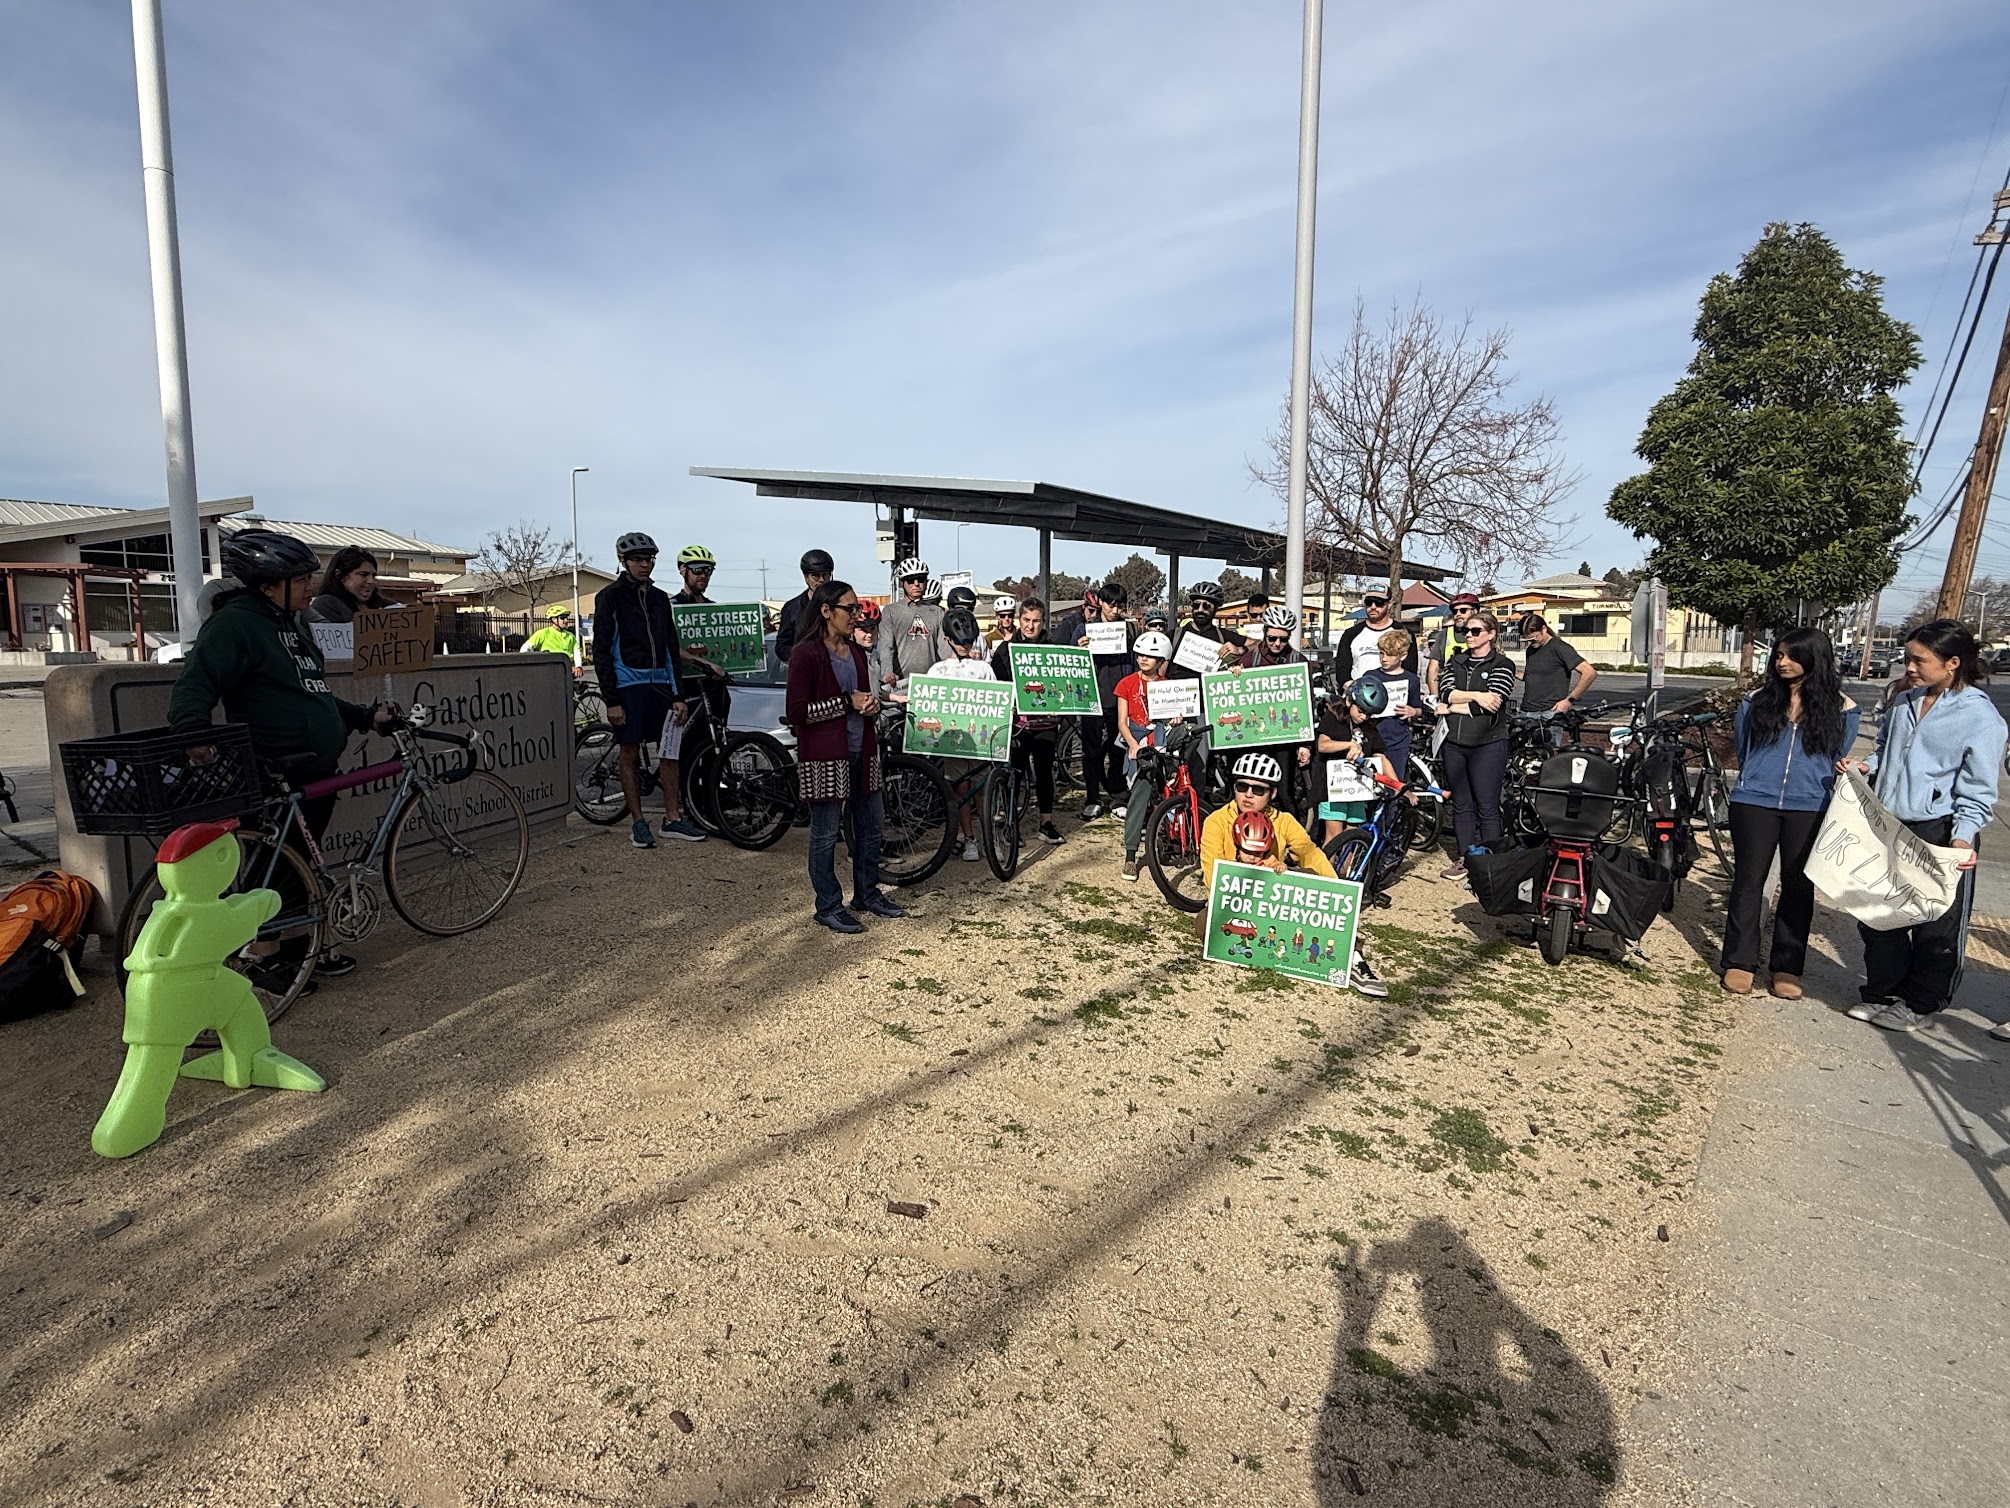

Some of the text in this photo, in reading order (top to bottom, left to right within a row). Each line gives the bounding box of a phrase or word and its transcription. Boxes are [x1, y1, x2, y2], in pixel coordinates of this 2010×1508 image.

[359, 610, 423, 634] INVEST
[677, 611, 759, 627] SAFE STREETS
[384, 632, 398, 642] IN
[681, 624, 757, 639] FOR EVERYONE
[358, 639, 430, 671] SAFETY
[1015, 652, 1091, 668] SAFE STREETS
[1018, 666, 1091, 679] FOR EVERYONE
[913, 684, 1009, 706] SAFE STREETS
[1208, 673, 1304, 696] SAFE STREETS
[413, 677, 527, 728] Gardens
[915, 700, 1005, 718] FOR EVERYONE
[1212, 689, 1302, 709] FOR EVERYONE
[482, 721, 557, 771] School
[465, 794, 506, 817] School
[1219, 875, 1353, 914] SAFE STREETS
[1850, 853, 1948, 922] LIVES
[1220, 895, 1347, 931] FOR EVERYONE
